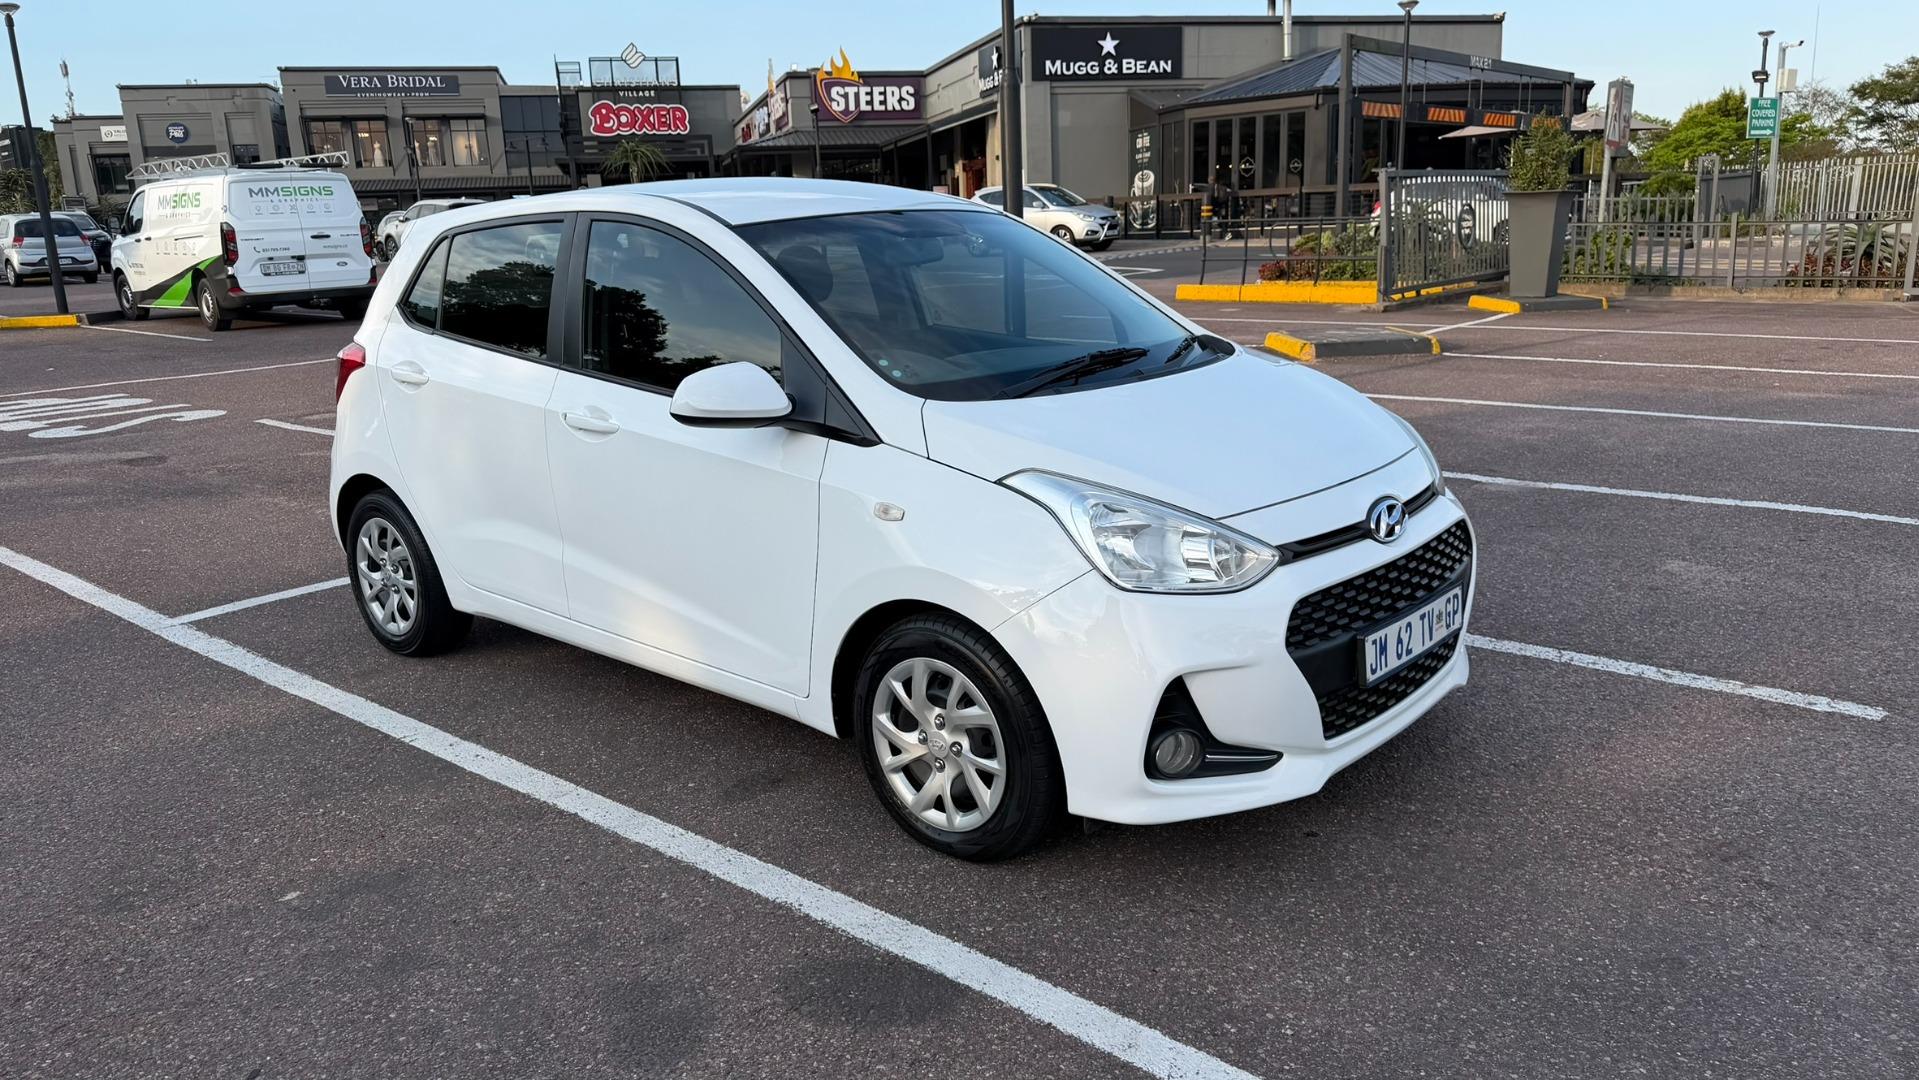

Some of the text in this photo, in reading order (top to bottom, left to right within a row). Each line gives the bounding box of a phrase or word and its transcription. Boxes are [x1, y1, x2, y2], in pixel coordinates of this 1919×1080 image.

[1045, 58, 1172, 76] MUGG & BEAN
[338, 75, 446, 88] VERA BRIDAL
[830, 85, 916, 112] STEERS
[589, 101, 690, 136] BOXER
[1752, 109, 1775, 118] COVERED
[1752, 119, 1774, 128] PARKING
[157, 191, 201, 210] MMSIGNS
[248, 185, 334, 198] MMSIGNS
[1369, 592, 1460, 676] JM 62 TV GP
